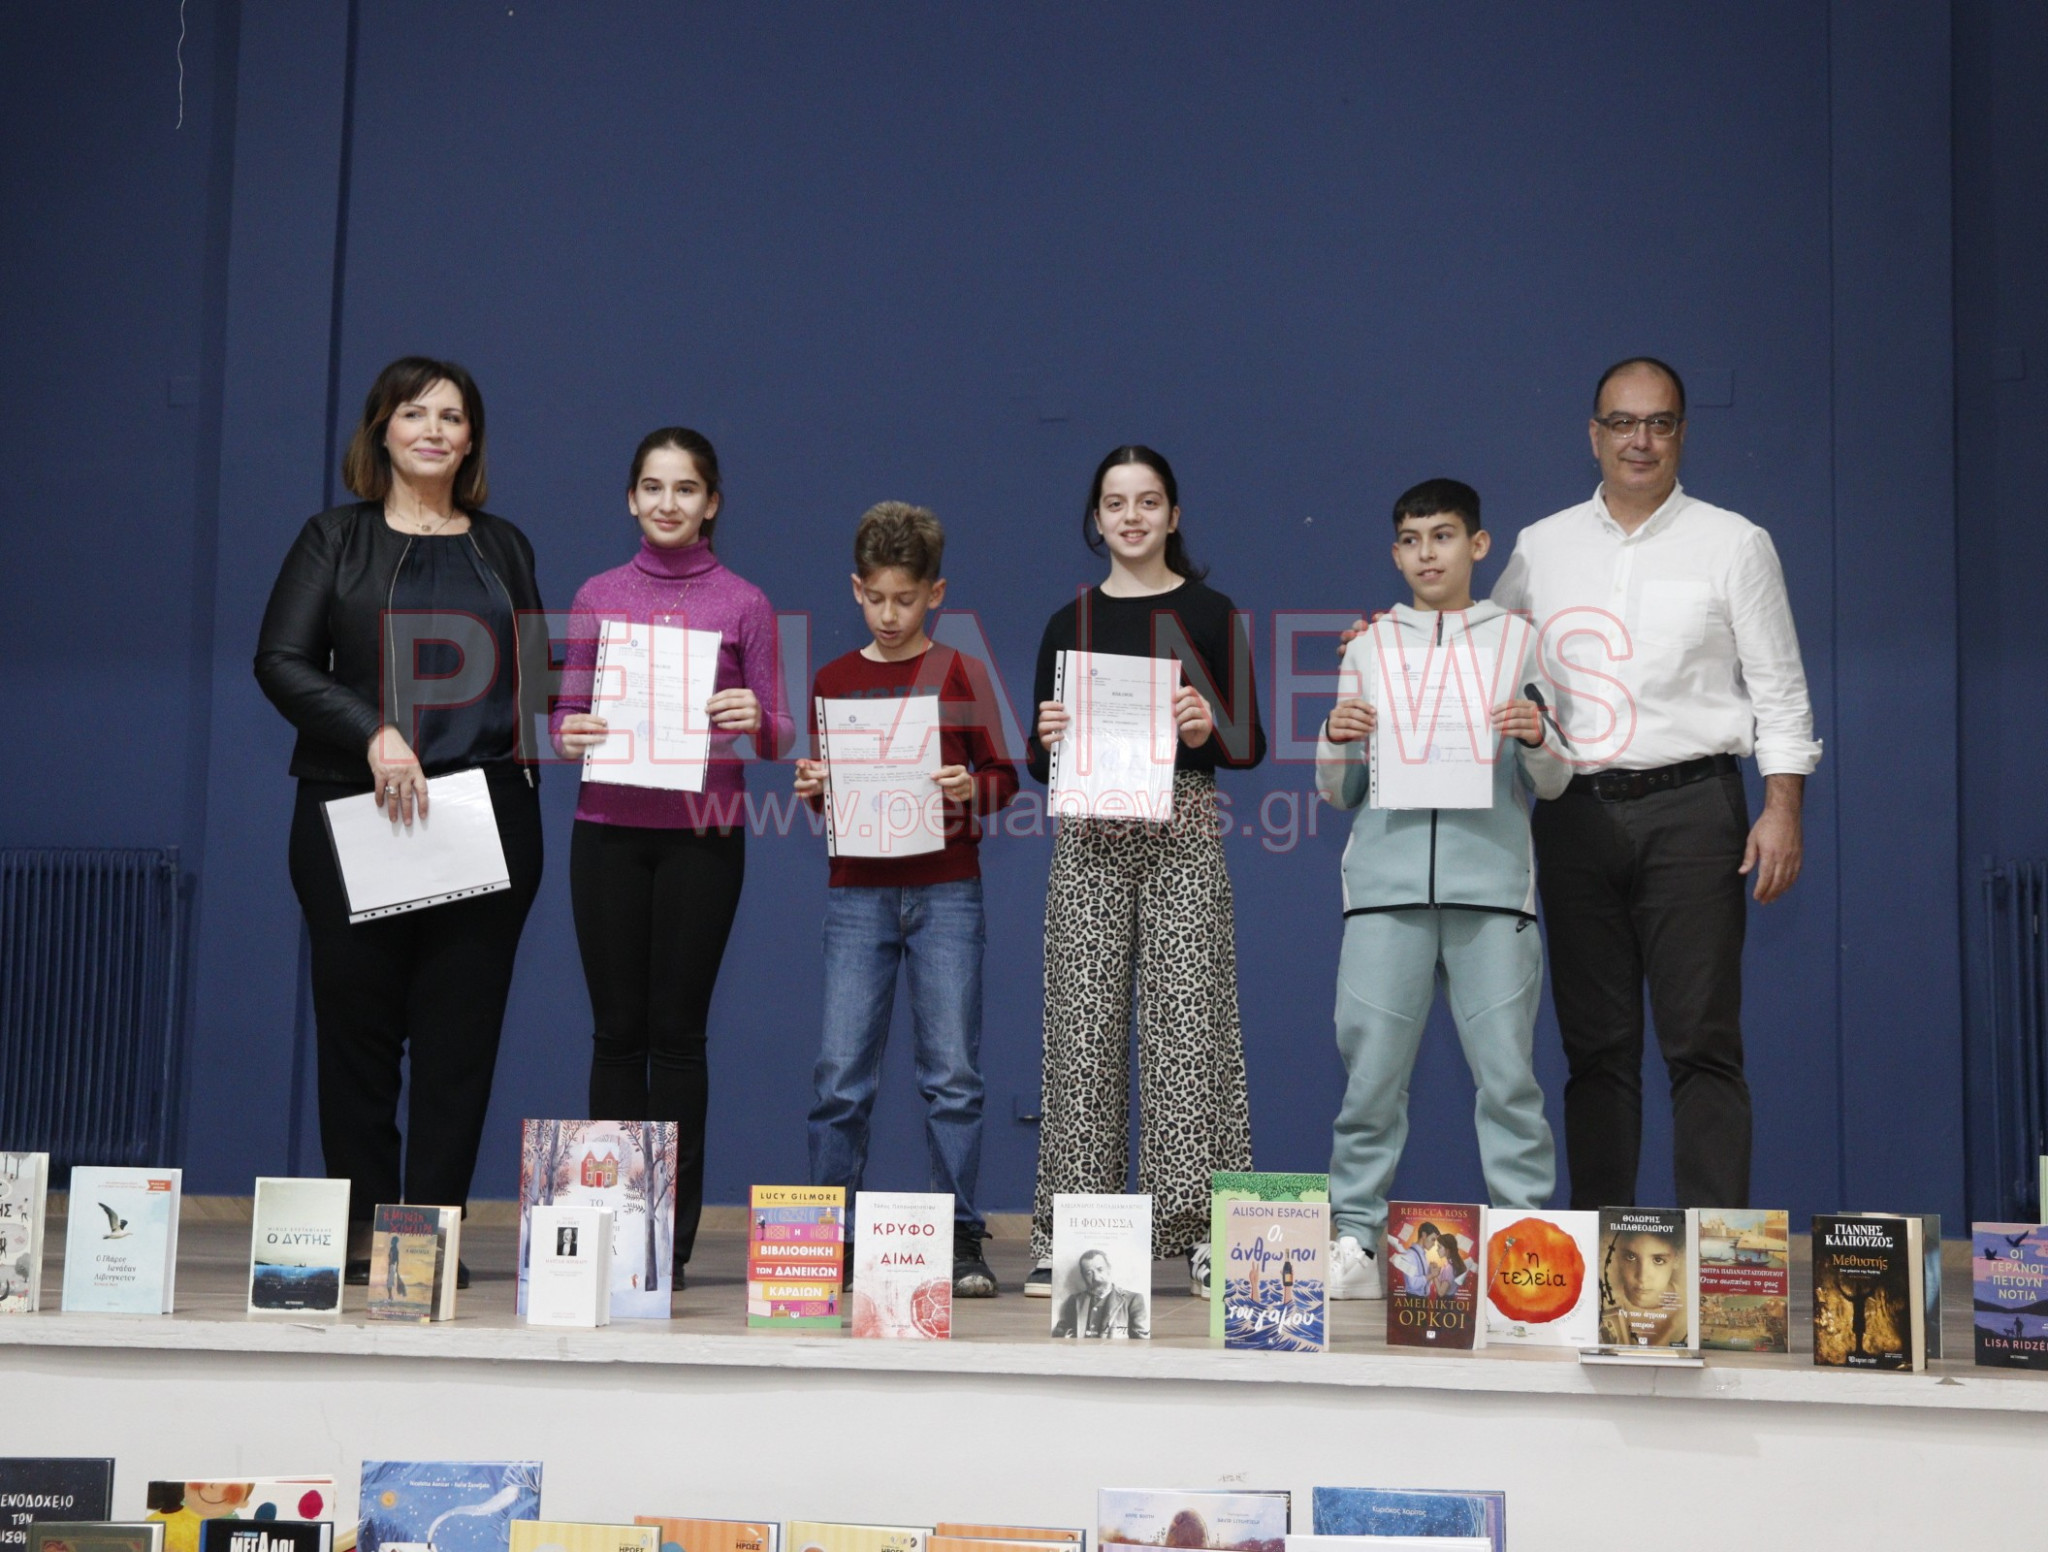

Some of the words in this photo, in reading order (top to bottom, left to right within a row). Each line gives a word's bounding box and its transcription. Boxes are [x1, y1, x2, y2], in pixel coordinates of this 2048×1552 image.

[791, 1193, 838, 1201] GILMORE
[1232, 1206, 1274, 1218] ALISON
[1277, 1208, 1319, 1219] ESPACH
[1400, 1207, 1443, 1217] REBECCA
[1445, 1209, 1468, 1218] ROSS
[873, 1222, 935, 1236] ΚΡΥΦΟ
[1081, 1218, 1134, 1229] ΦΟΝΙΣΣΑ
[1834, 1223, 1883, 1236] ΓΙΑΝΝΗΣ
[267, 1233, 278, 1244] Ο
[282, 1233, 332, 1246] ΔΥΤΗΣ
[1825, 1234, 1894, 1248] ΚΑΛΠΟΥΖΟΣ
[760, 1245, 834, 1257] ΒΙΒΛΙΟΘΗΚΗ
[2009, 1249, 2023, 1260] ΟΙ
[880, 1252, 926, 1266] ΑΙΜΑ
[1526, 1252, 1540, 1268] η
[1832, 1253, 1888, 1271] Μεθυστής
[775, 1267, 838, 1277] ΔΑΝΕΙΚΩΝ
[1990, 1262, 2044, 1275] ΓΕΡΑΝΟΙ
[1500, 1268, 1567, 1287] τελεία
[1993, 1275, 2043, 1288] ΠΕΤΟΥΝ
[769, 1287, 823, 1297] ΚΑΡΔΙΩΝ
[1998, 1289, 2037, 1301] ΝΟΤΙΑ
[1394, 1298, 1470, 1311] ΑΜΕΙΛΙΚΤΟΙ
[1399, 1310, 1465, 1329] ΟΡΚΟΙ
[1985, 1338, 2009, 1348] LISA
[2012, 1339, 2048, 1351] RIDZÉ
[0, 1493, 74, 1508] ΕΝΟΔΟΧΕΙΟ
